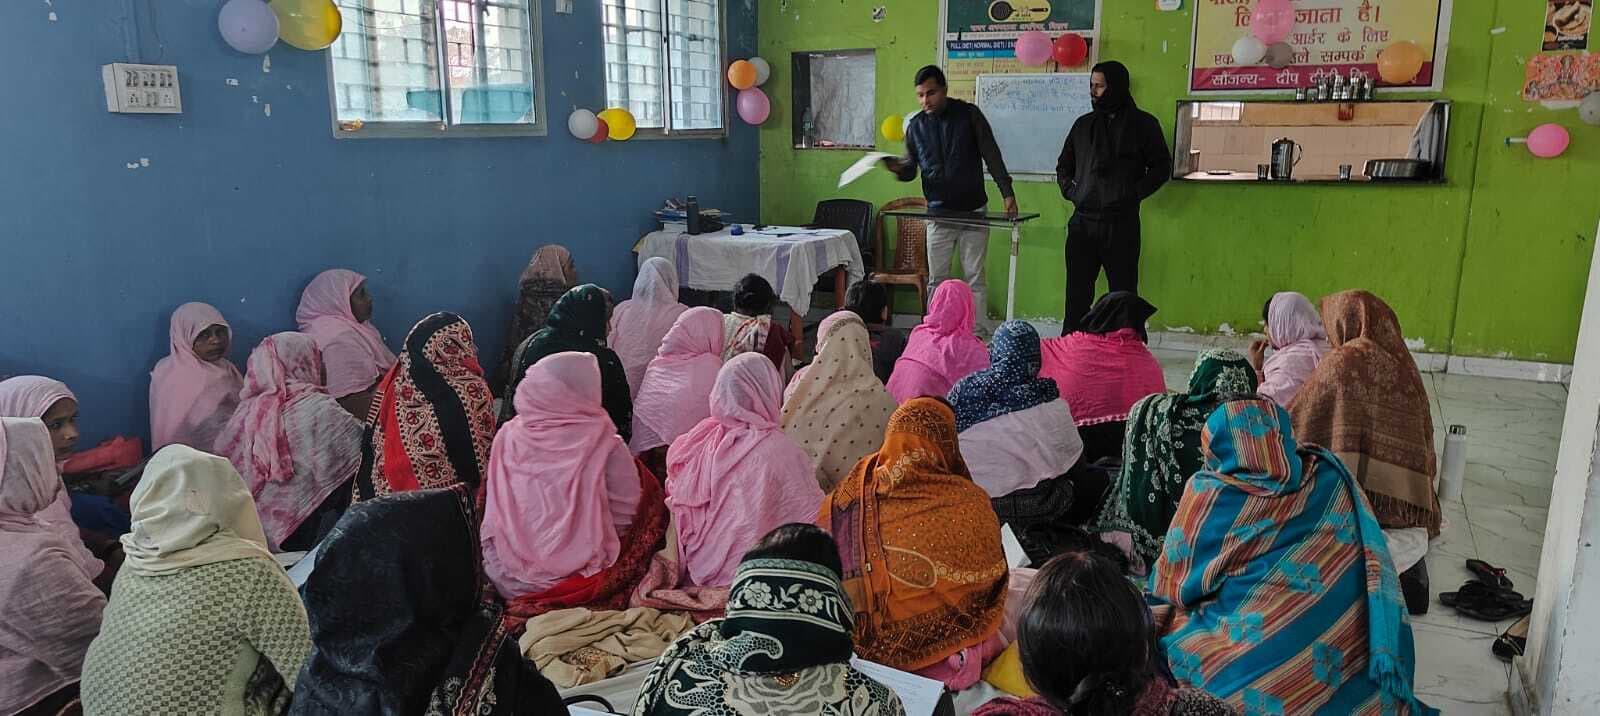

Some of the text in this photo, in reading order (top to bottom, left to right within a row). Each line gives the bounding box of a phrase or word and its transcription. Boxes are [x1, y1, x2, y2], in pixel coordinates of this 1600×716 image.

[1295, 8, 1342, 24] जाता
[1338, 28, 1351, 43] के
[1363, 26, 1388, 43] लिए
[1276, 69, 1299, 85] दीप
